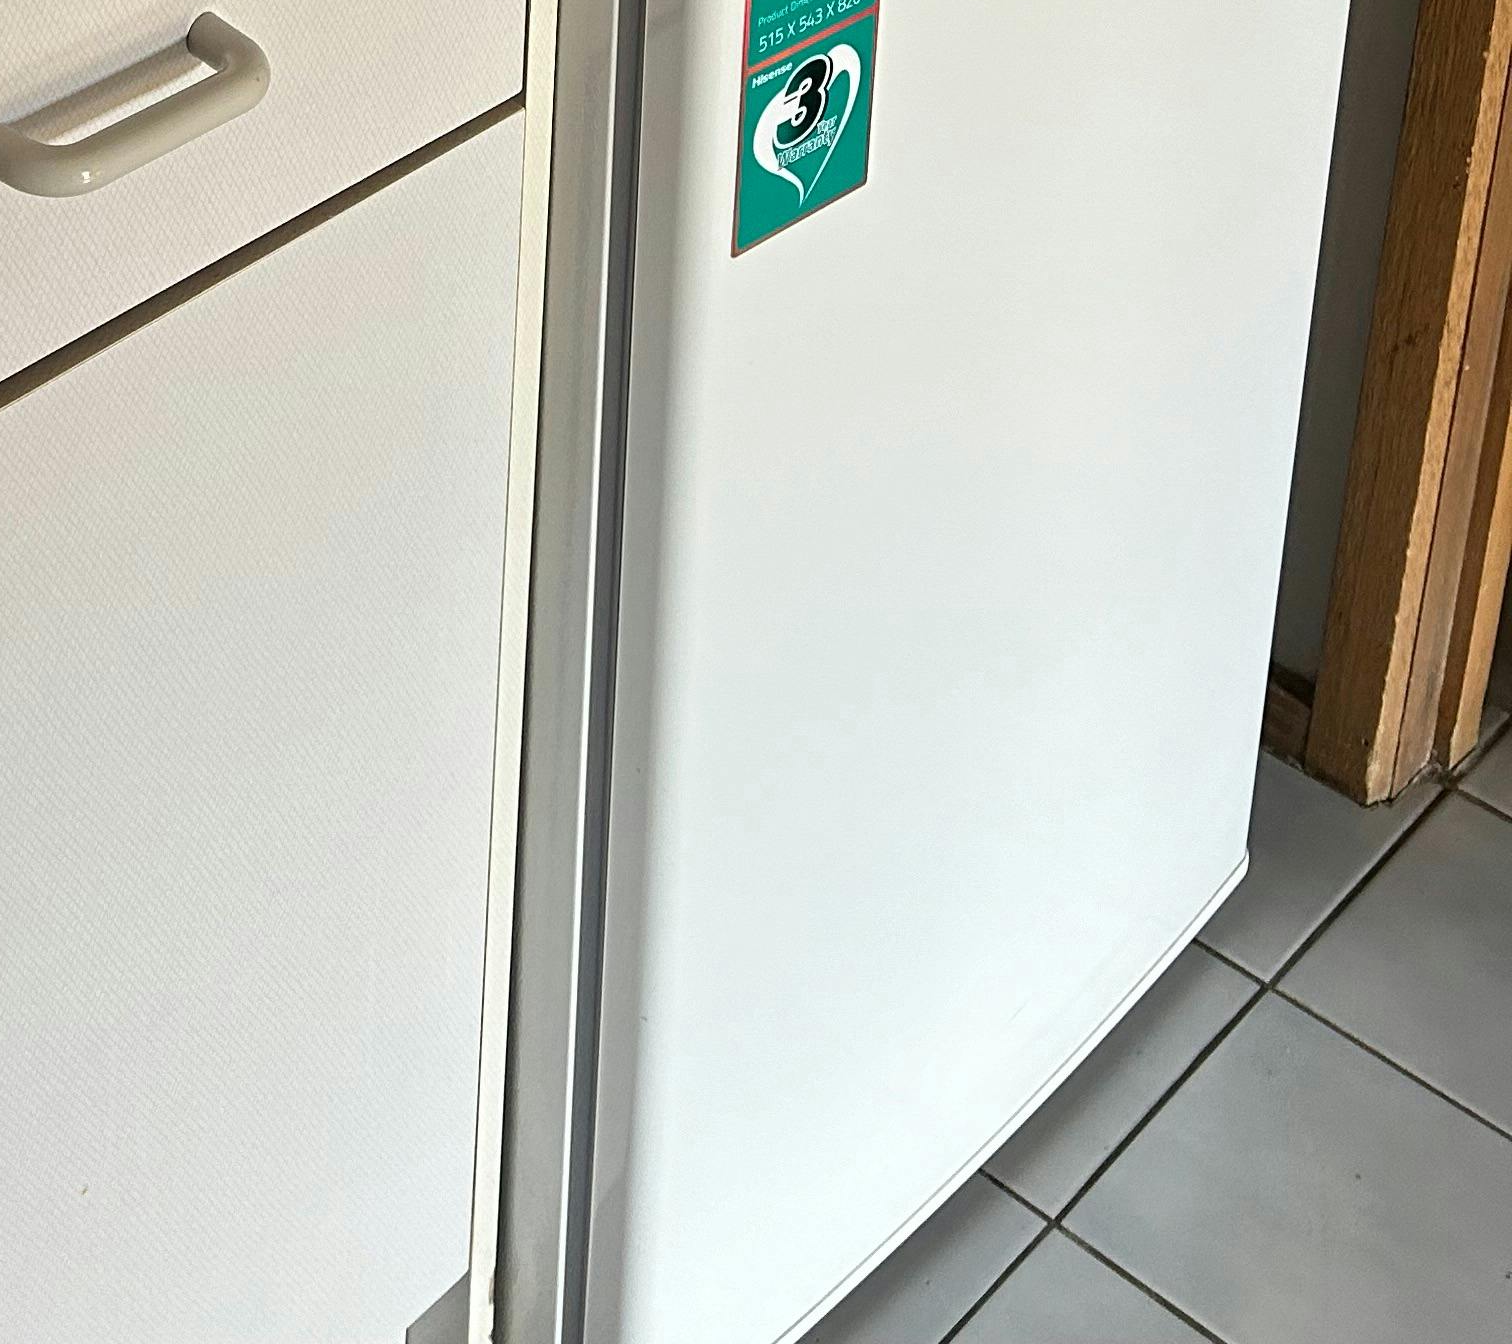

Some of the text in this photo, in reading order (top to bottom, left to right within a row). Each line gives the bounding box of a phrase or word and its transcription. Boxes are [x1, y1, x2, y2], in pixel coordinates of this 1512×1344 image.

[758, 5, 788, 27] Product
[758, 27, 784, 53] 515
[788, 22, 796, 38] X
[799, 7, 823, 33] 543
[826, 2, 835, 17] X
[752, 62, 792, 89] Hisense
